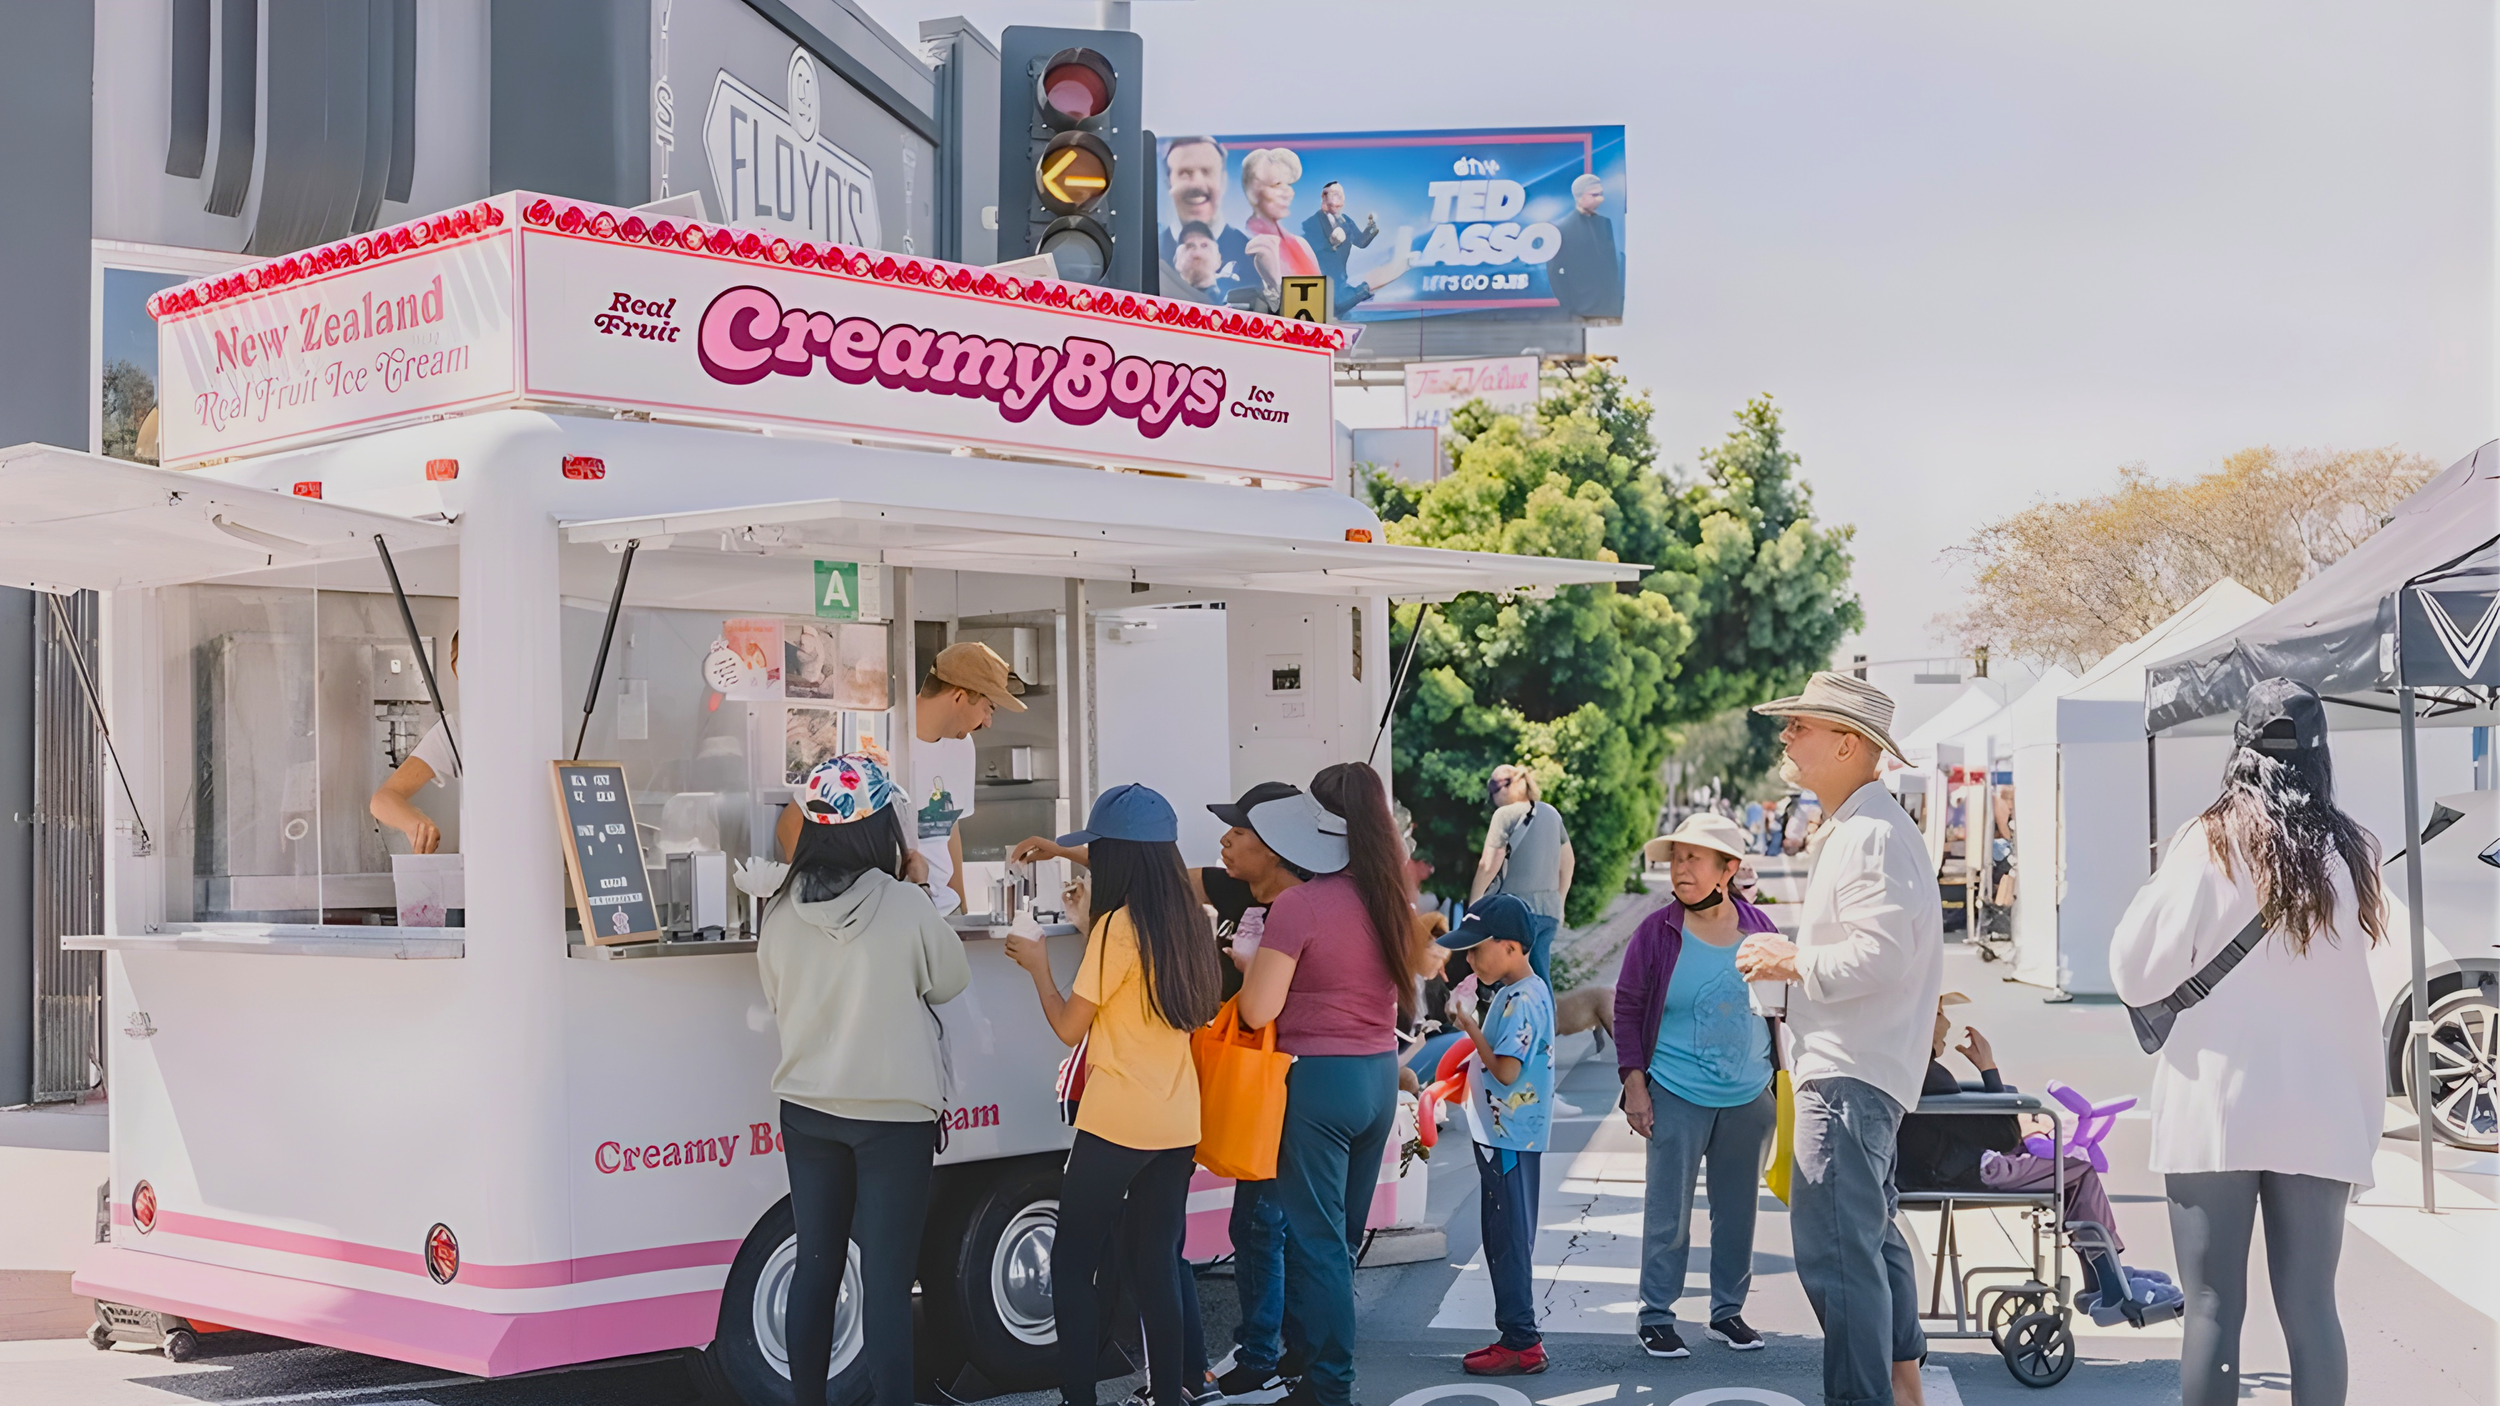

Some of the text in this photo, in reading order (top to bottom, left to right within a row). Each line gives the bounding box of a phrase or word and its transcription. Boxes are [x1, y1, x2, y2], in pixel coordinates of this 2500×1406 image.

[1428, 179, 1526, 223] TED
[215, 274, 444, 374] New Zealand
[608, 292, 677, 318] Real
[594, 313, 681, 343] Fruit
[194, 345, 469, 432] Real Fruit Ice Cream
[1248, 385, 1274, 403] Ice
[823, 570, 850, 607] A
[594, 1132, 739, 1174] Creamy
